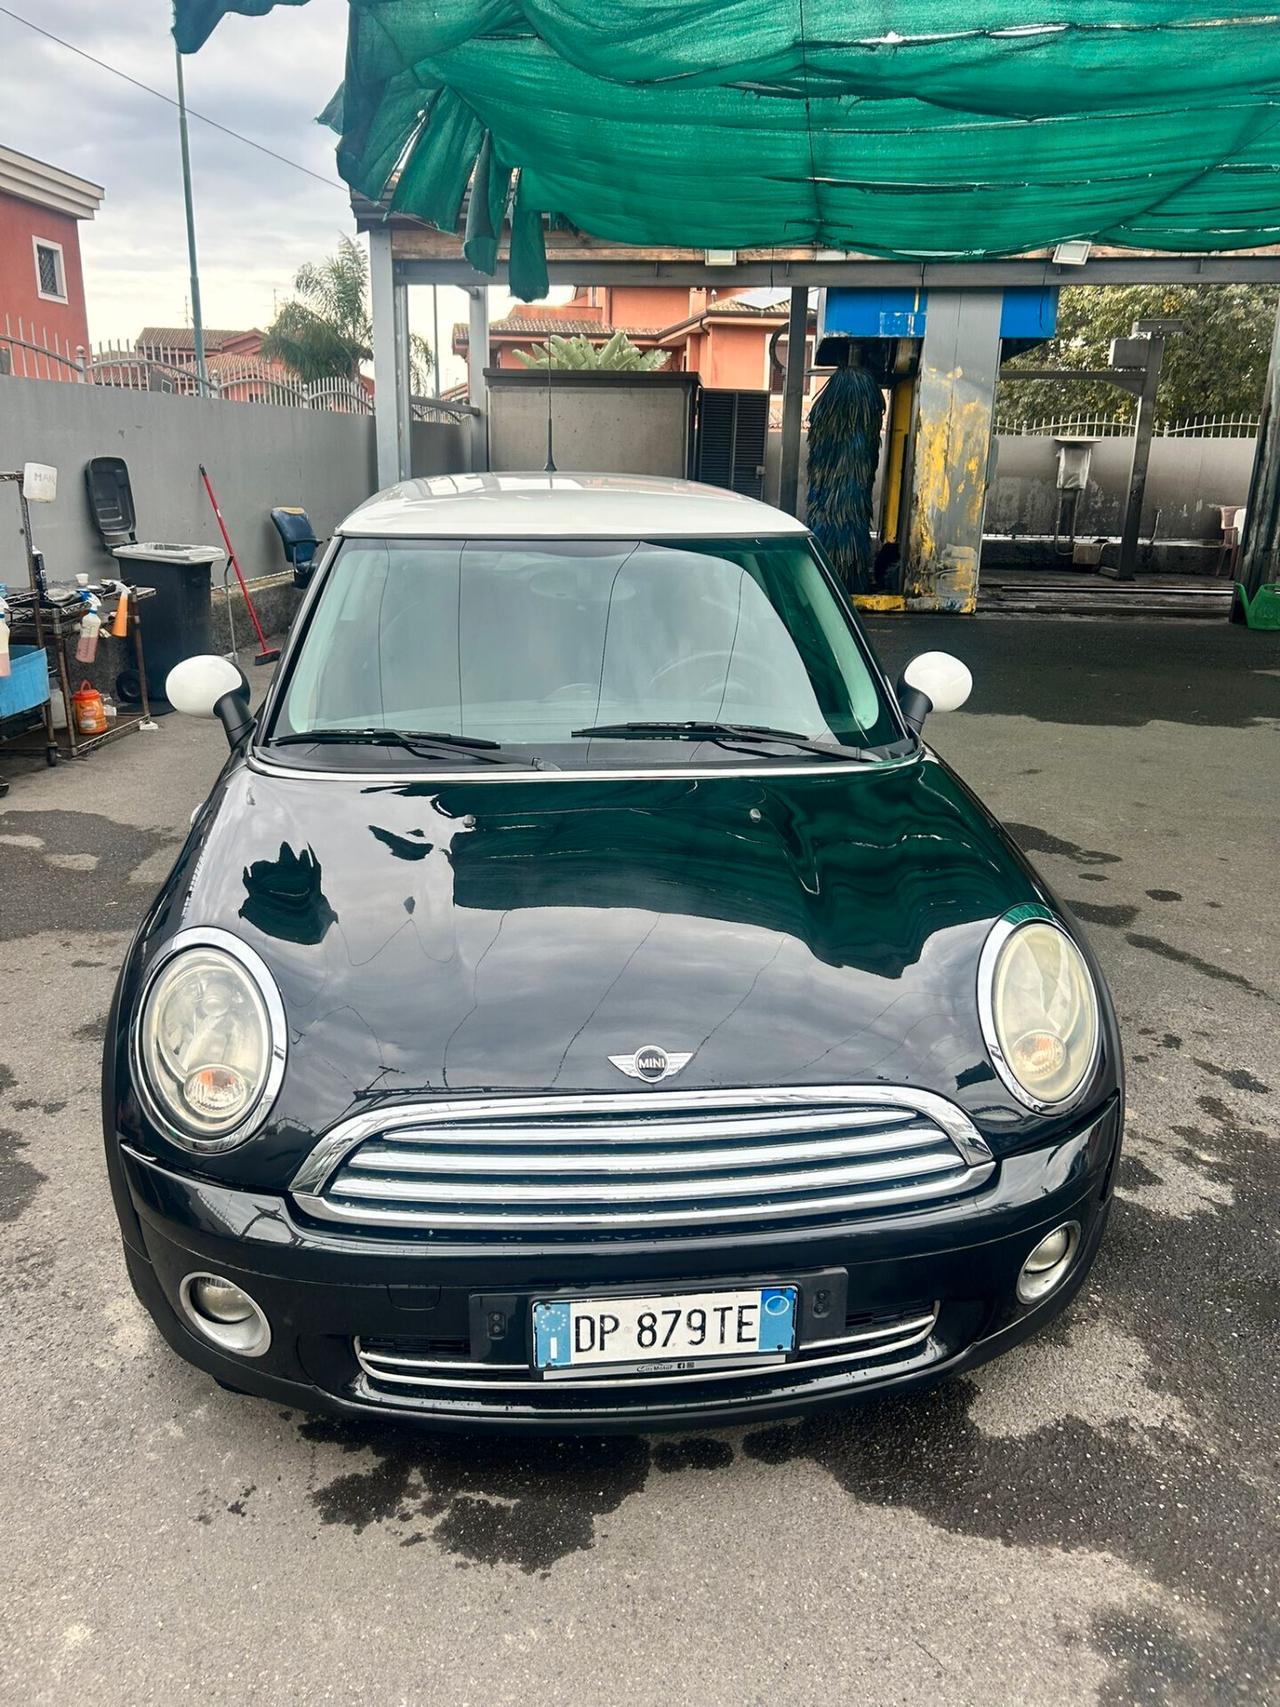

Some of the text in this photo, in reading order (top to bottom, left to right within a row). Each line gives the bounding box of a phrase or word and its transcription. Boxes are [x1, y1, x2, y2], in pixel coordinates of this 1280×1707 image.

[639, 1058, 665, 1069] MINI
[574, 1304, 758, 1353] DP 879TE
